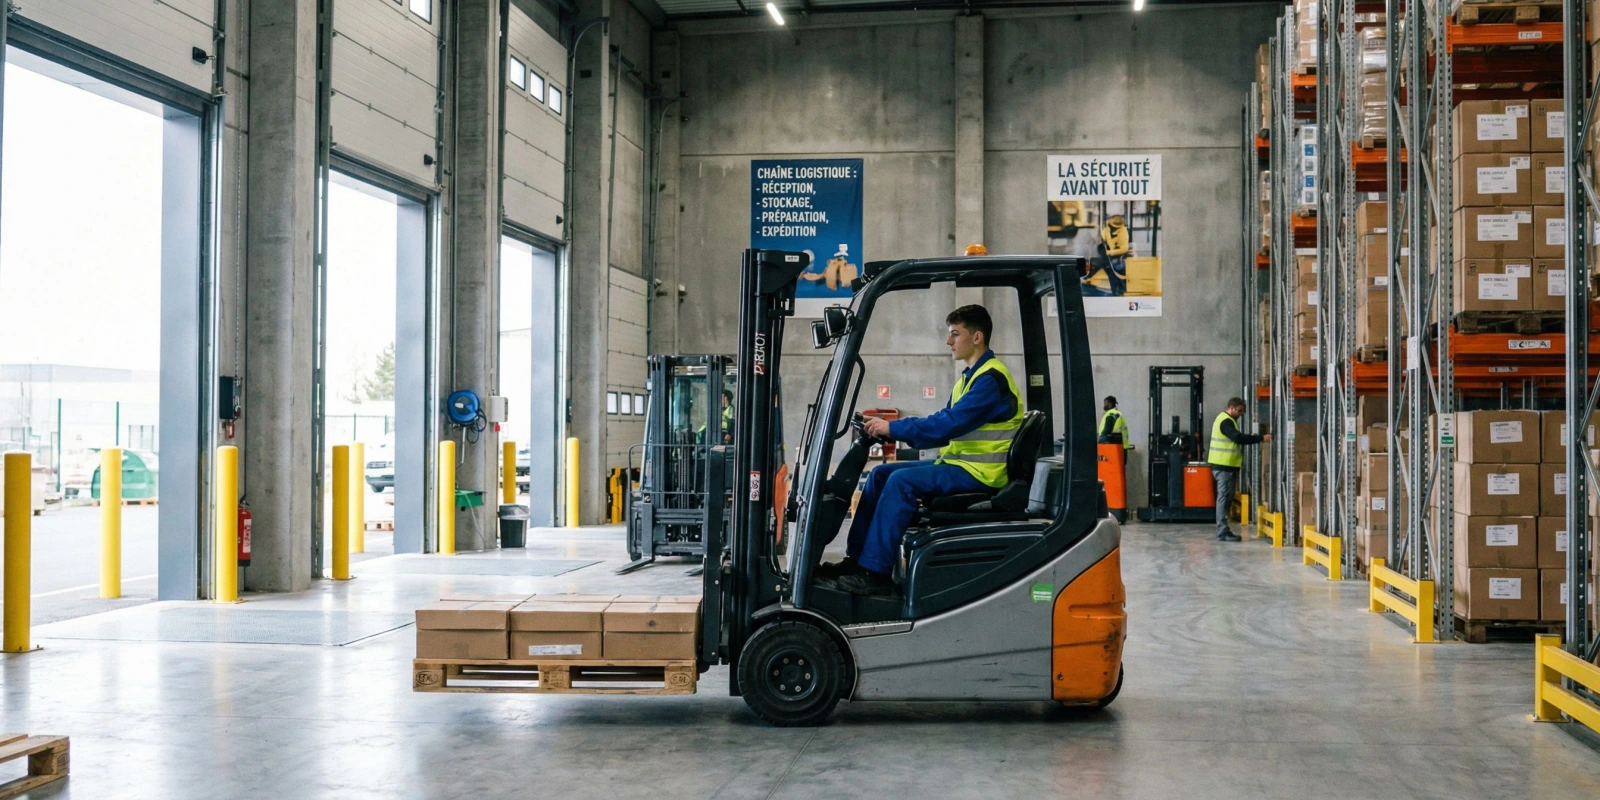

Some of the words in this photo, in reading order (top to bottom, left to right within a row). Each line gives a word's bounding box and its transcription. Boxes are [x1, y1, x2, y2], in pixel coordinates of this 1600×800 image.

[757, 165, 793, 178] CHAÎNE
[795, 167, 851, 179] LOGISTIQUE
[1058, 162, 1076, 177] LA
[1080, 158, 1150, 177] SÉCURITÉ
[762, 180, 816, 195] RÉCEPTION,
[1060, 180, 1107, 195] AVANT
[1112, 179, 1149, 195] TOUT
[762, 197, 813, 209] STOCKAGE,
[762, 209, 829, 224] PRÉPARATION,
[762, 224, 816, 237] EXPÉDITION
